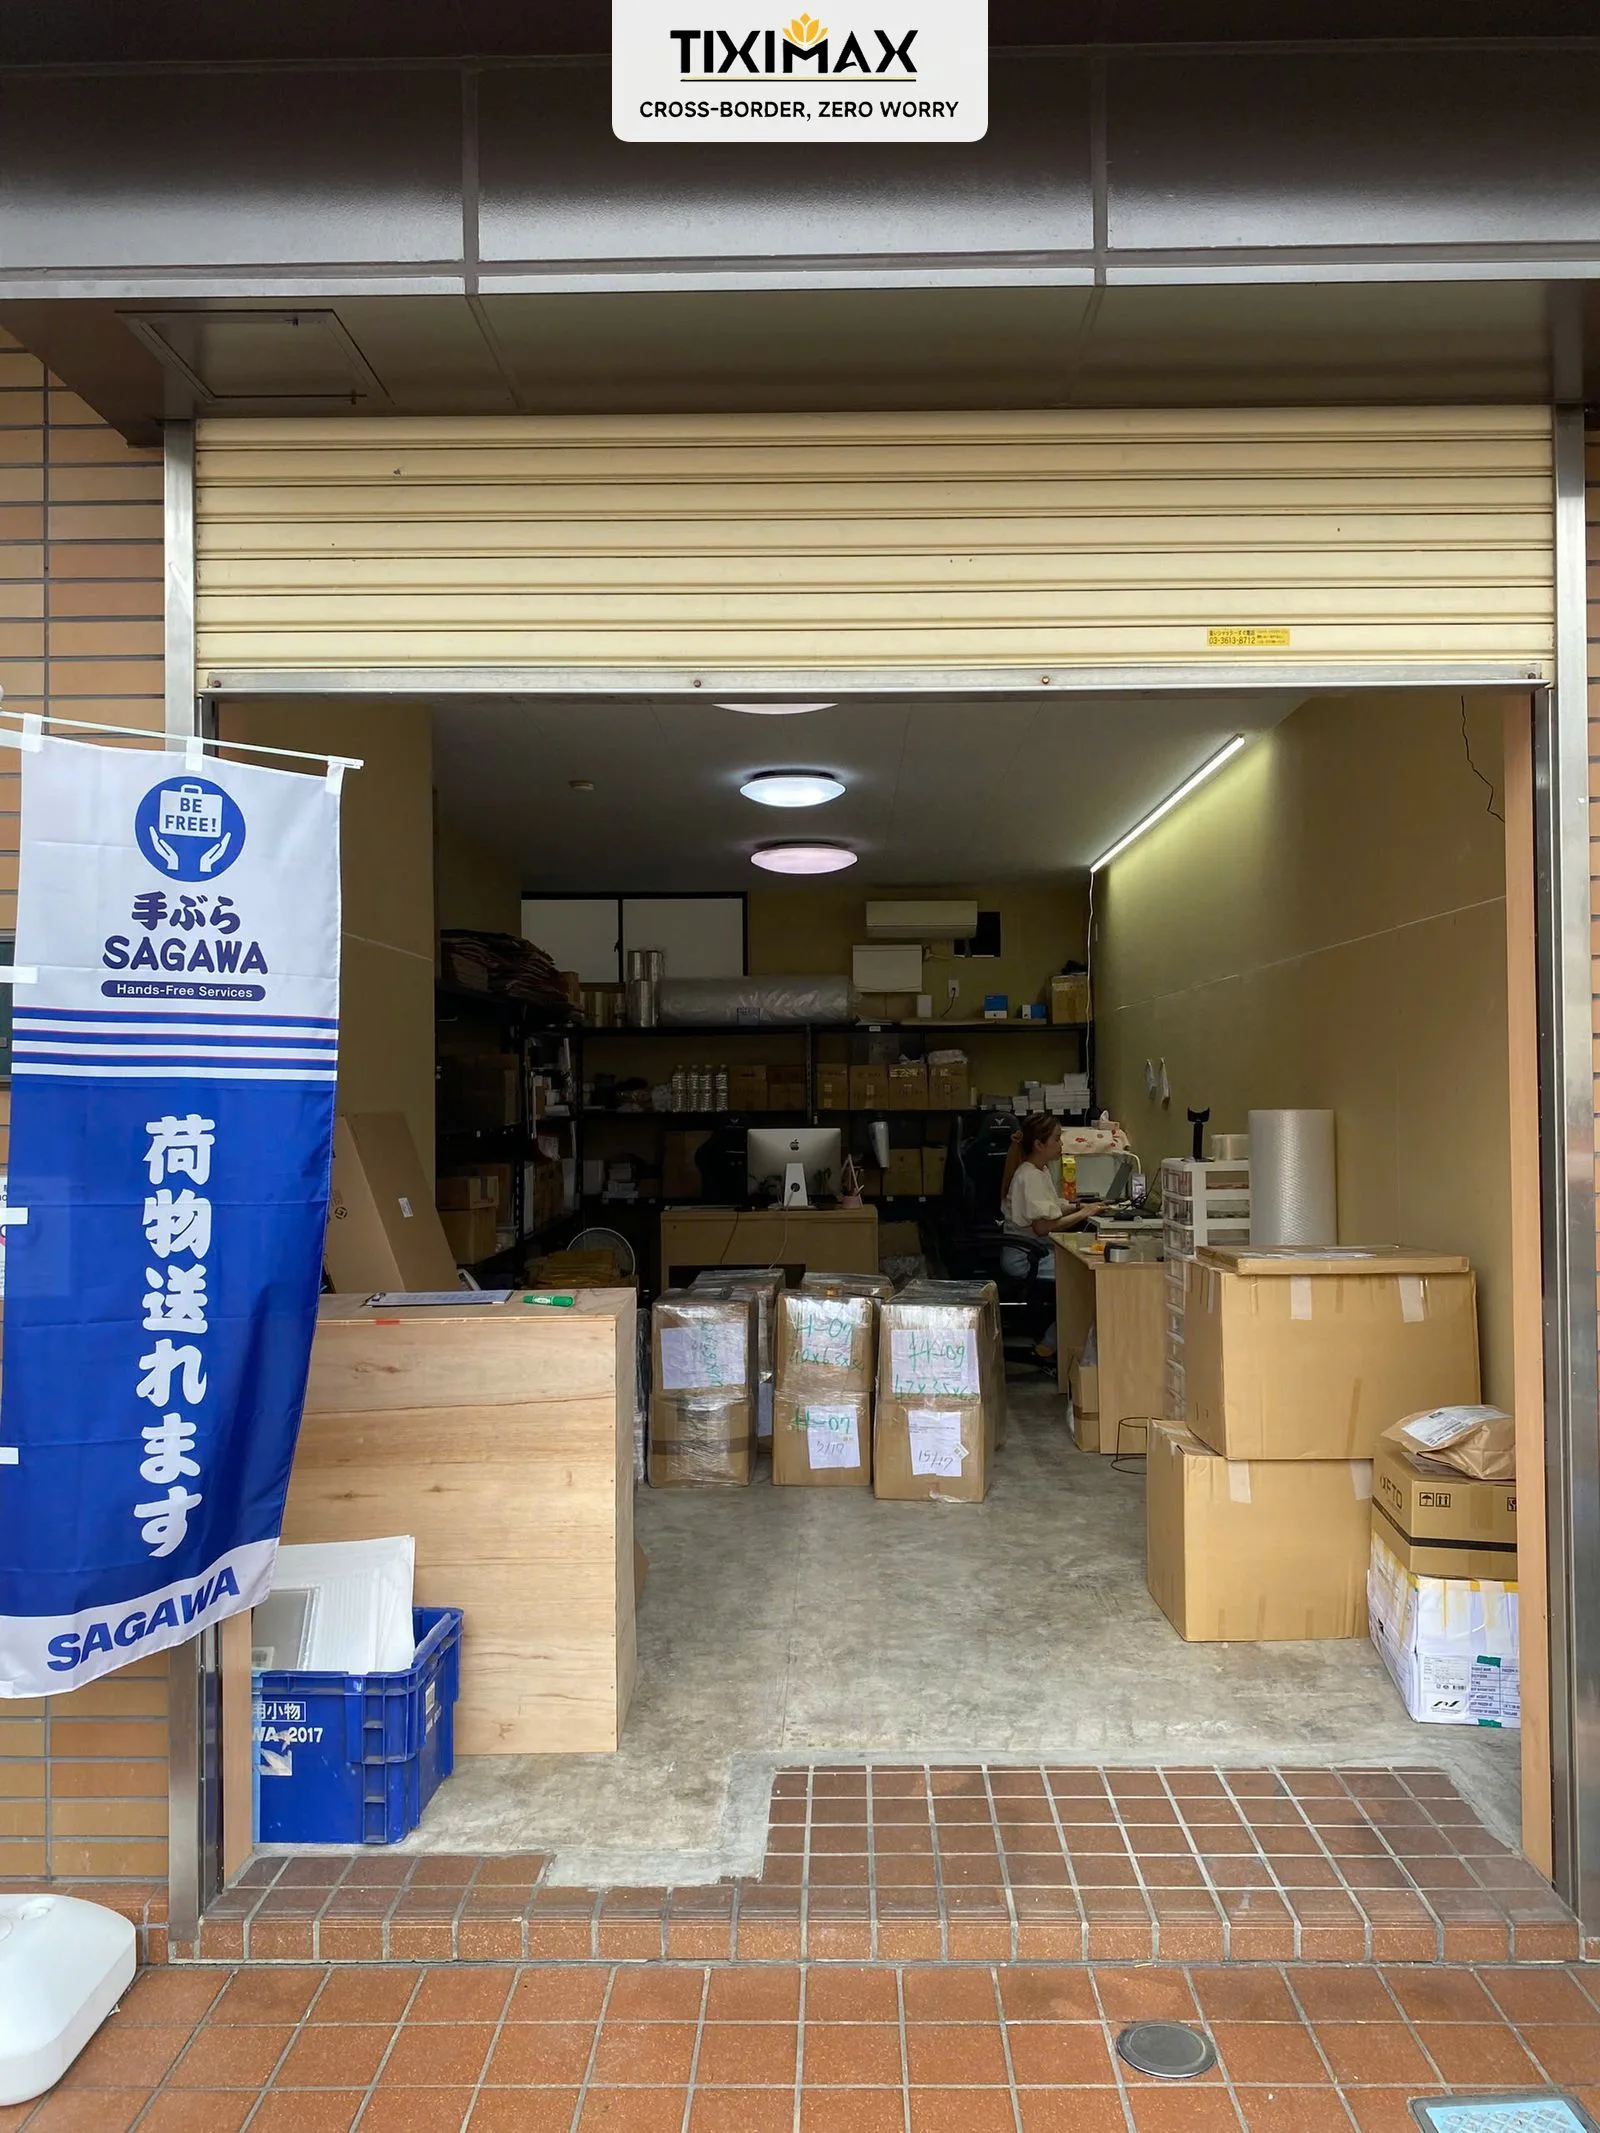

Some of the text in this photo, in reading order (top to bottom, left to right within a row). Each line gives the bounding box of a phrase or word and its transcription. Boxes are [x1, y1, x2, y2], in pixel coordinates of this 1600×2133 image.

[179, 797, 203, 813] BE
[164, 814, 217, 833] FREE!
[131, 890, 241, 934] 手ぶら
[102, 935, 268, 975] SAGAWA
[116, 983, 253, 999] Hands-Free Services
[133, 1113, 216, 1558] 荷物送れます
[47, 1566, 240, 1672] SAGAWA
[288, 1726, 324, 1743] 2017
